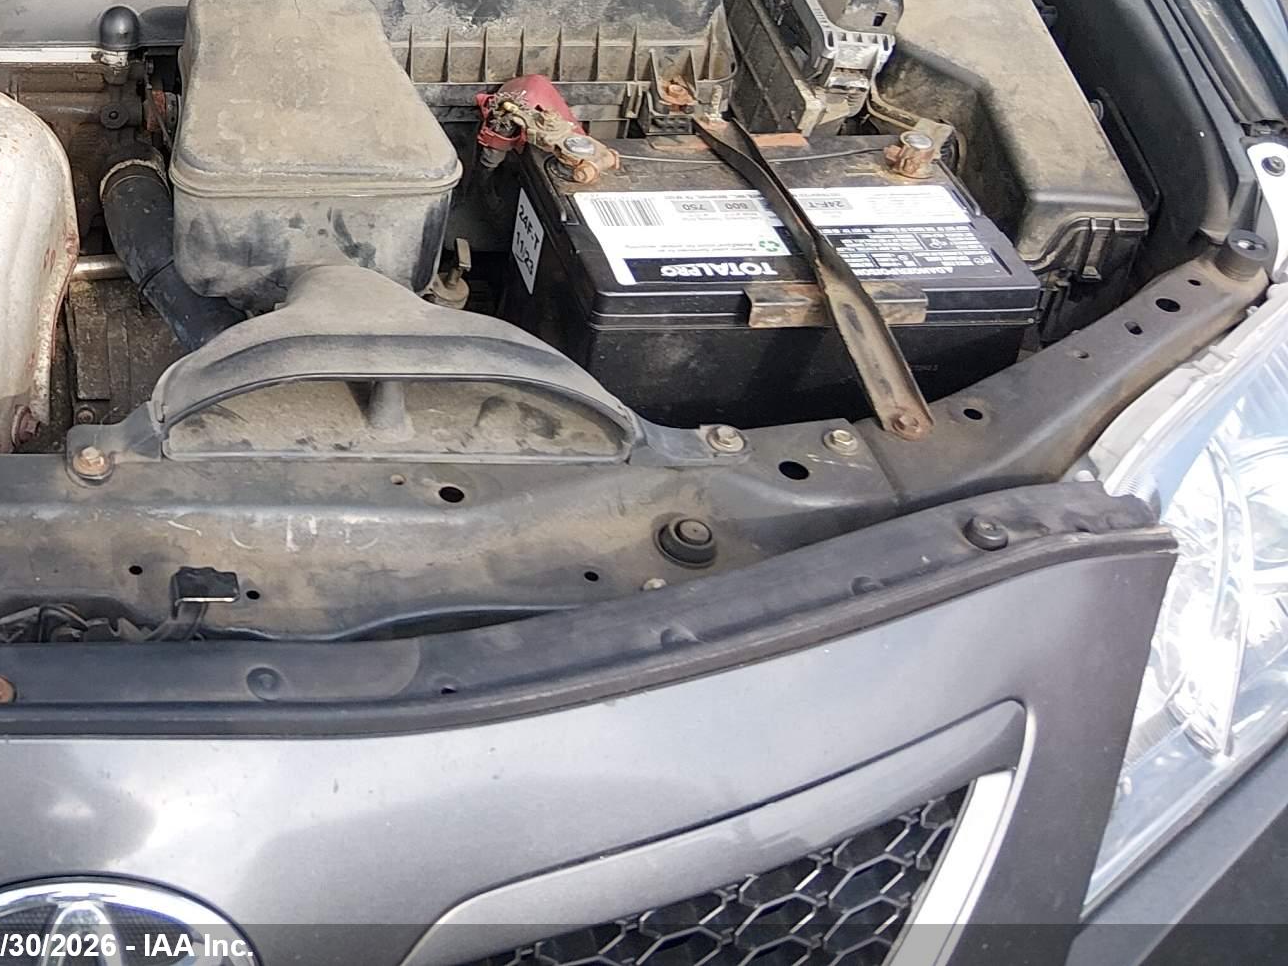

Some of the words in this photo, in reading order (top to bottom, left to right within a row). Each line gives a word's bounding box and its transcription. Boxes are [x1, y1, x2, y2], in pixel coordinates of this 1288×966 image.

[682, 203, 707, 211] 750
[518, 203, 541, 250] 24F-T
[660, 262, 778, 276] TOTALPRO
